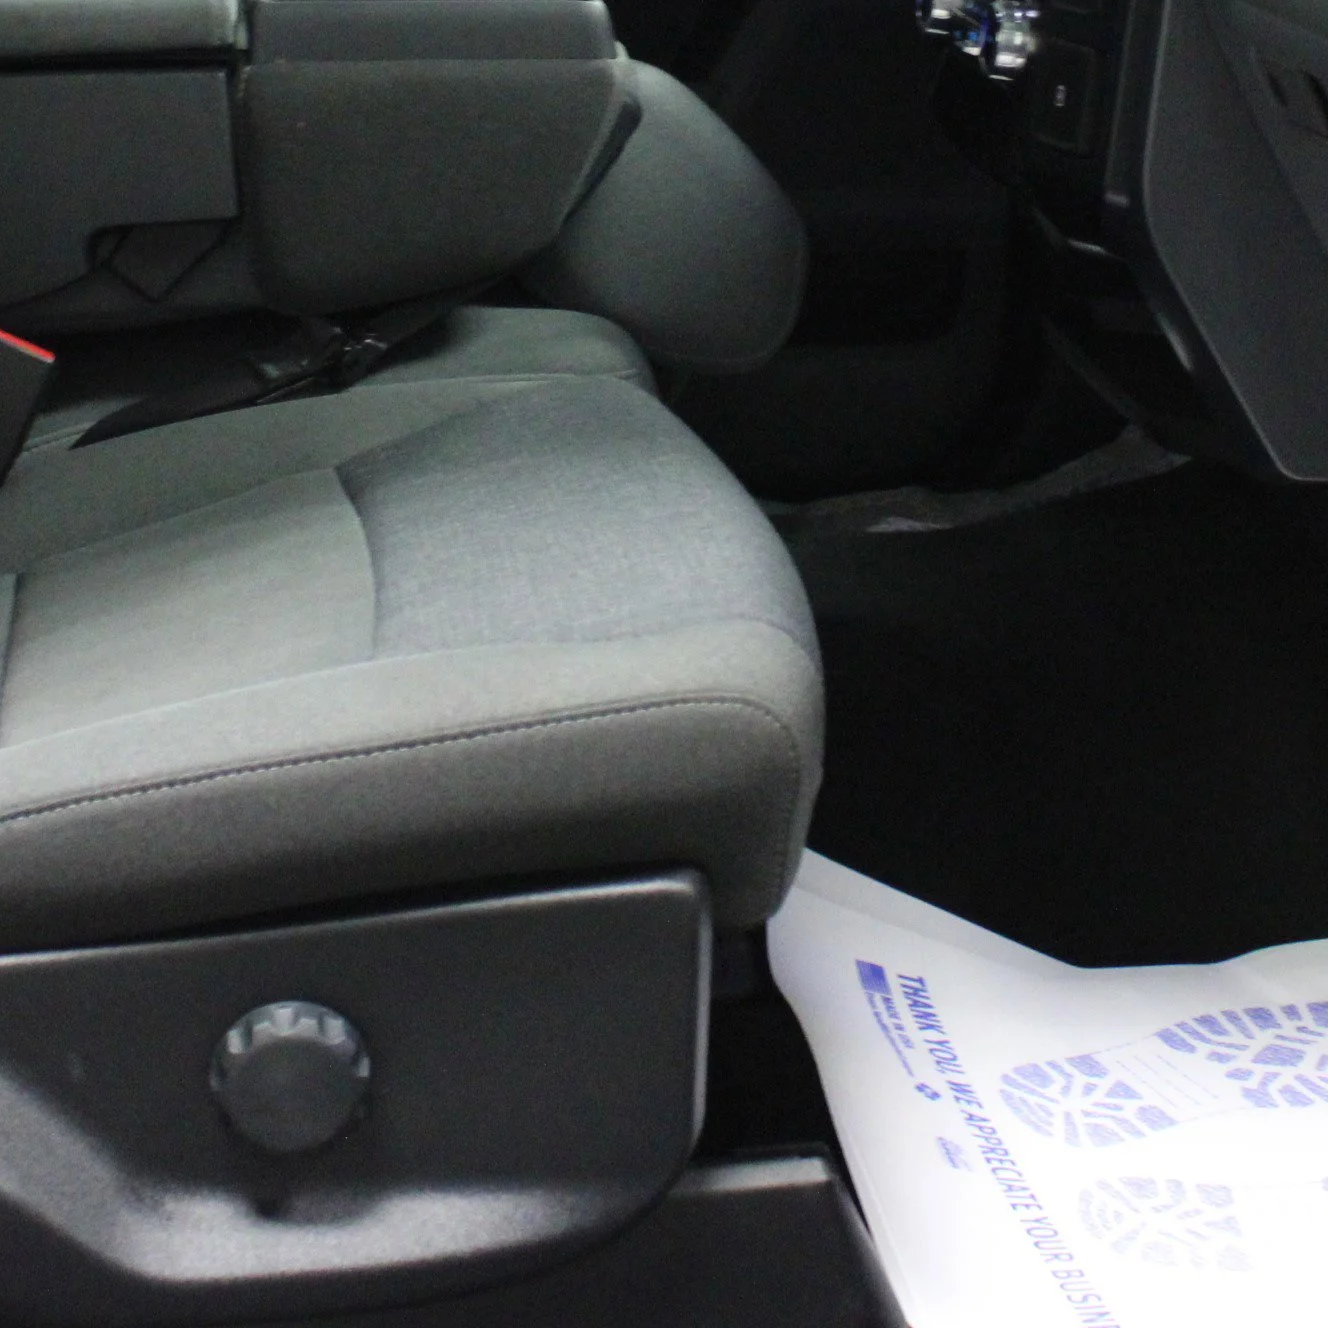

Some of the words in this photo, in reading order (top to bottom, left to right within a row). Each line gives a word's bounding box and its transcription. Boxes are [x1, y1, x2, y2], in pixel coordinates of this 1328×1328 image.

[896, 973, 948, 1036] THANK
[945, 1080, 985, 1110] WE
[959, 1108, 1044, 1211] APPRECIATE
[1019, 1215, 1075, 1264] YOUR
[1050, 1268, 1122, 1328] BUSIN
